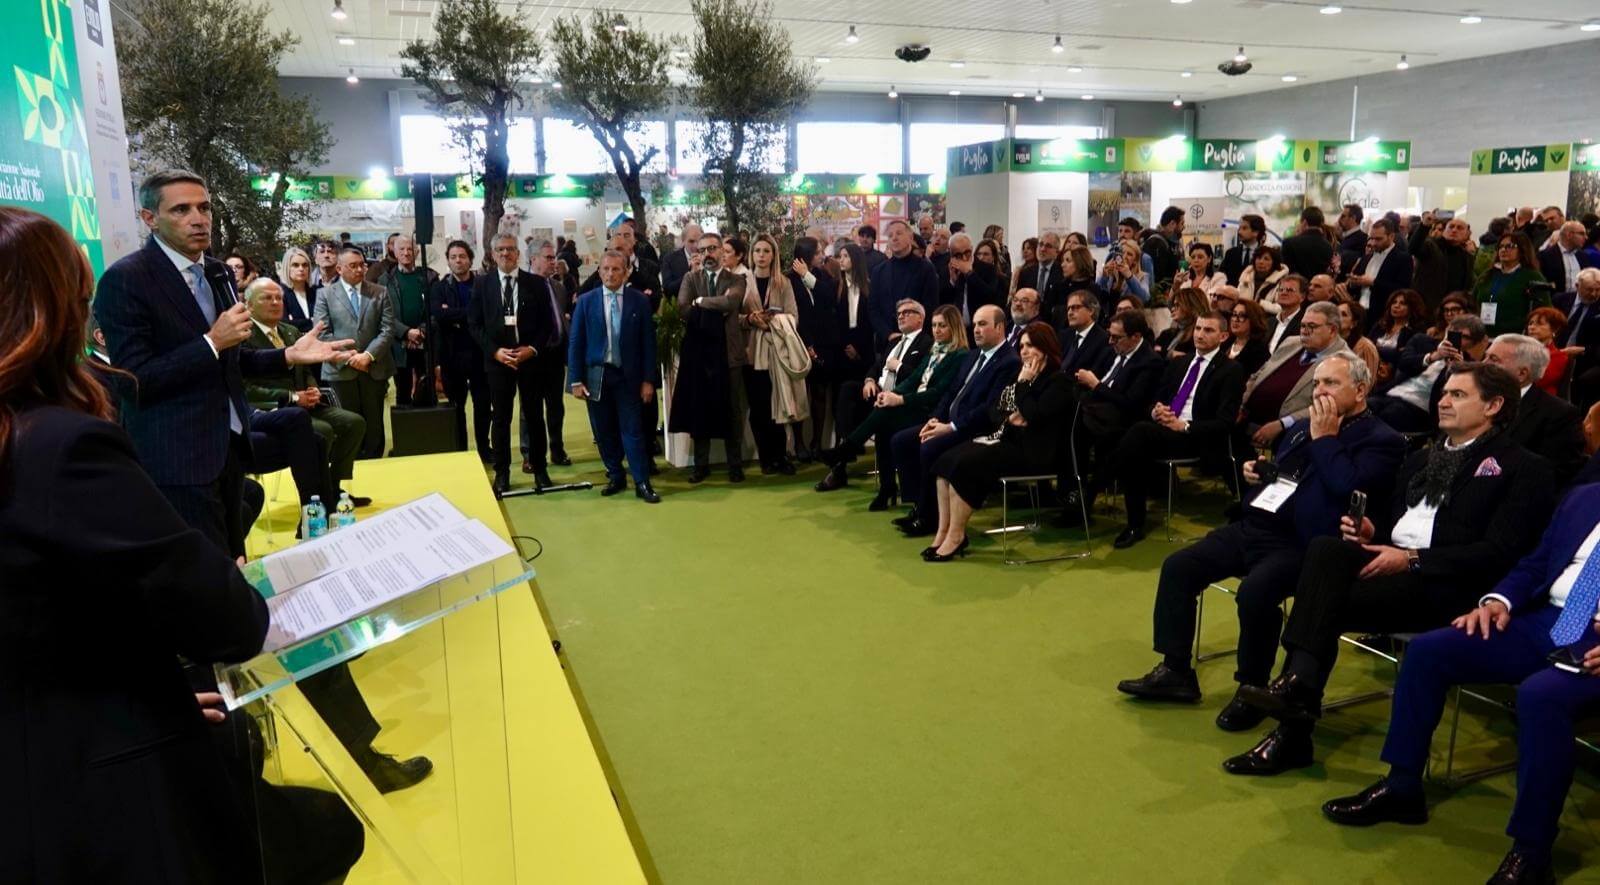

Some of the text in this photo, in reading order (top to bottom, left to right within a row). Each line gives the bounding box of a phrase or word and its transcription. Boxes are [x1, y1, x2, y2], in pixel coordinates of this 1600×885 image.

[963, 145, 989, 172] Puglia
[1204, 142, 1246, 168] Puglia
[1498, 149, 1538, 171] Puglia
[893, 175, 921, 192] Puglia
